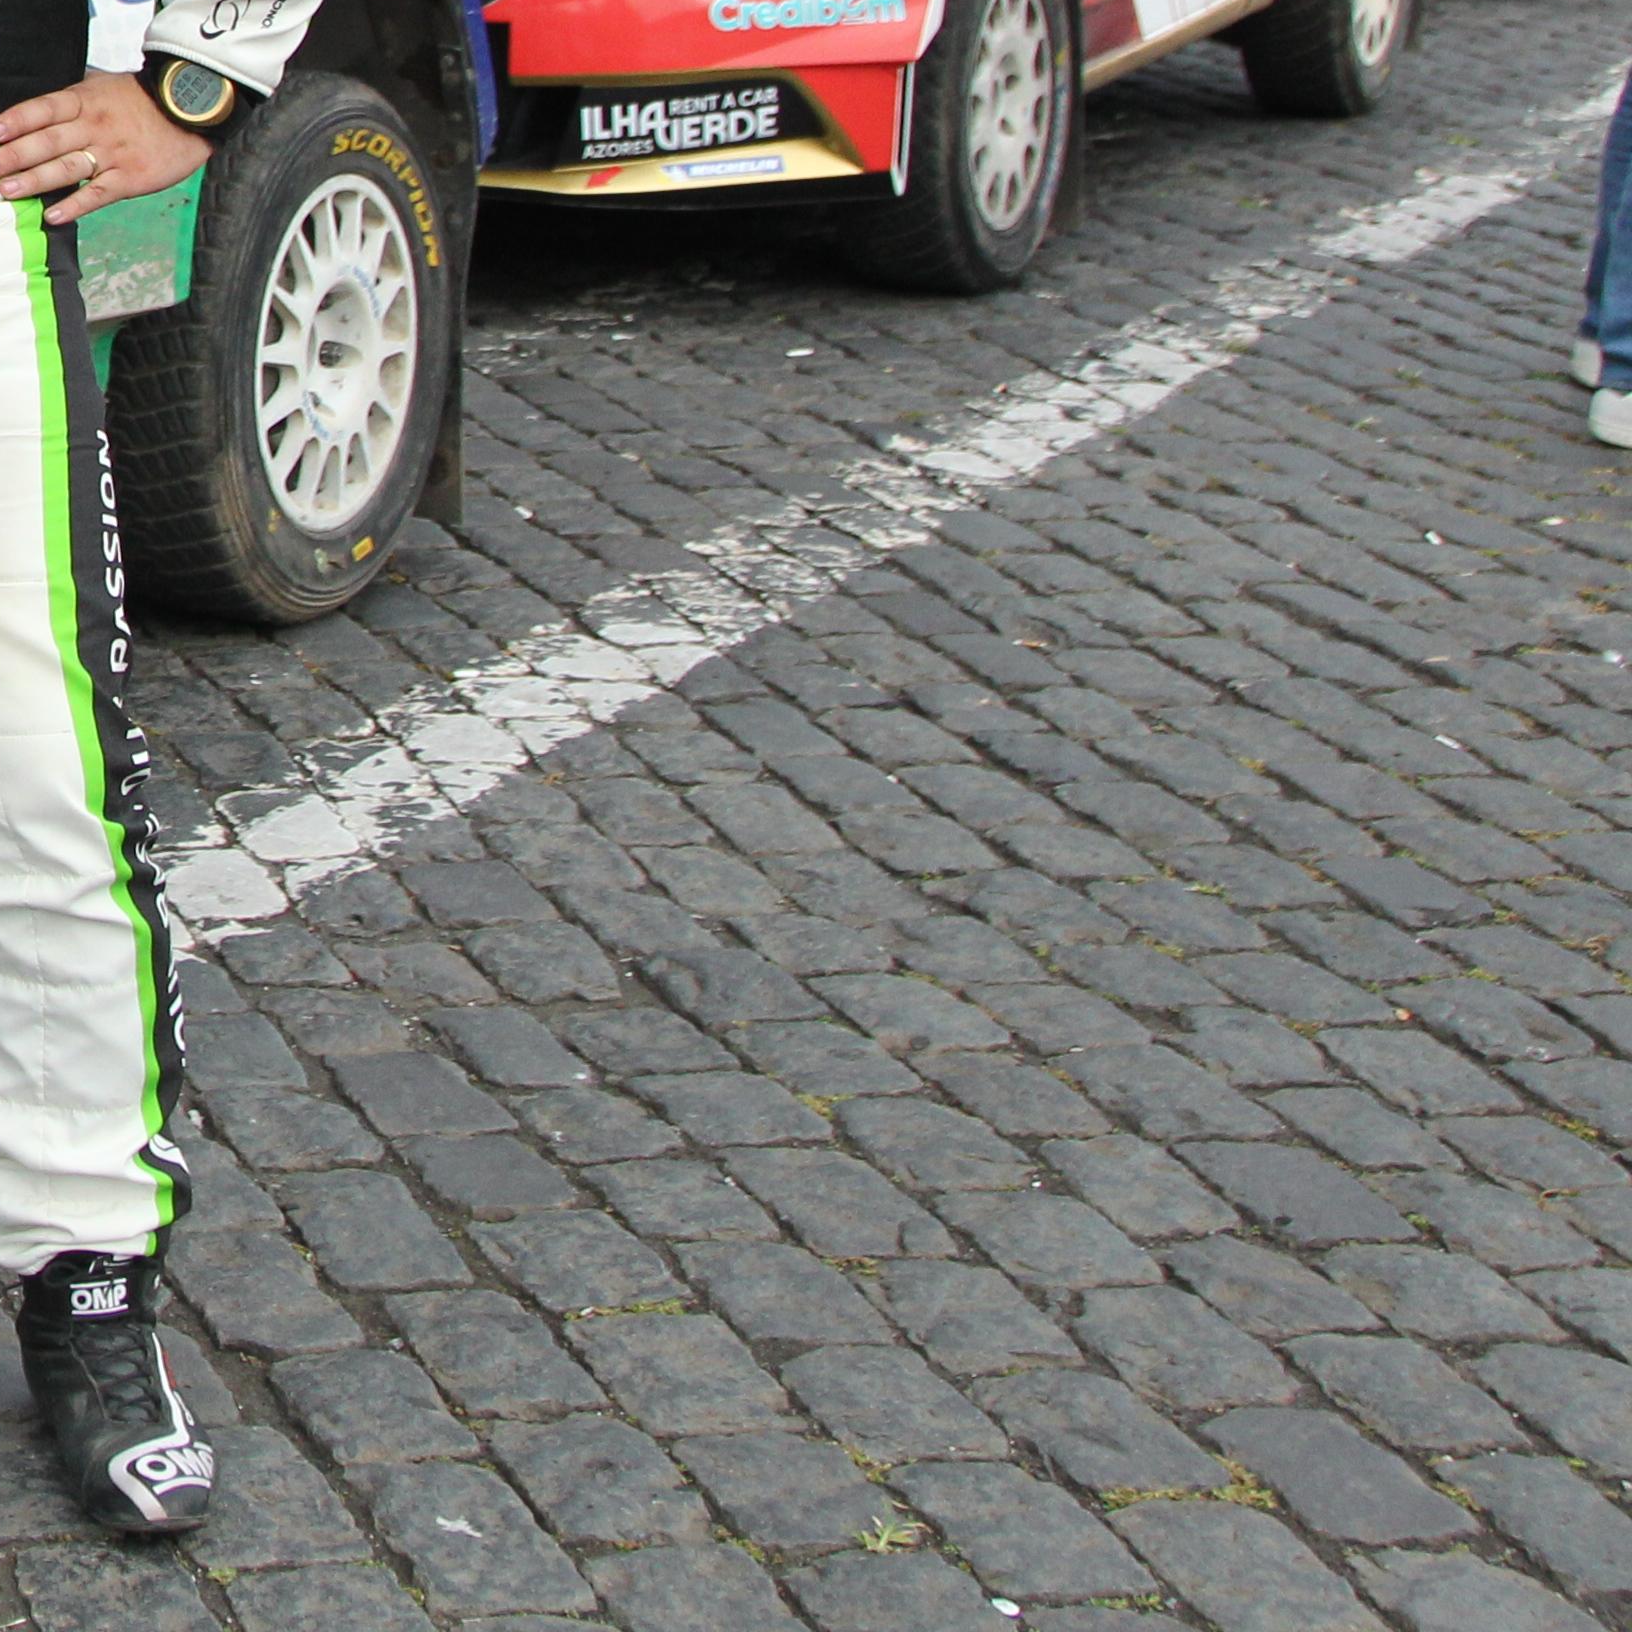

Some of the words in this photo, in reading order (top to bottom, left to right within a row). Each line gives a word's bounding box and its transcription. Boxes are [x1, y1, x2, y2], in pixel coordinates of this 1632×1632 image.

[580, 99, 666, 142] ILHA
[668, 93, 722, 116] RENT
[721, 91, 737, 108] A
[737, 85, 779, 107] CAR
[582, 136, 655, 160] AZORES
[71, 1283, 127, 1313] OMP
